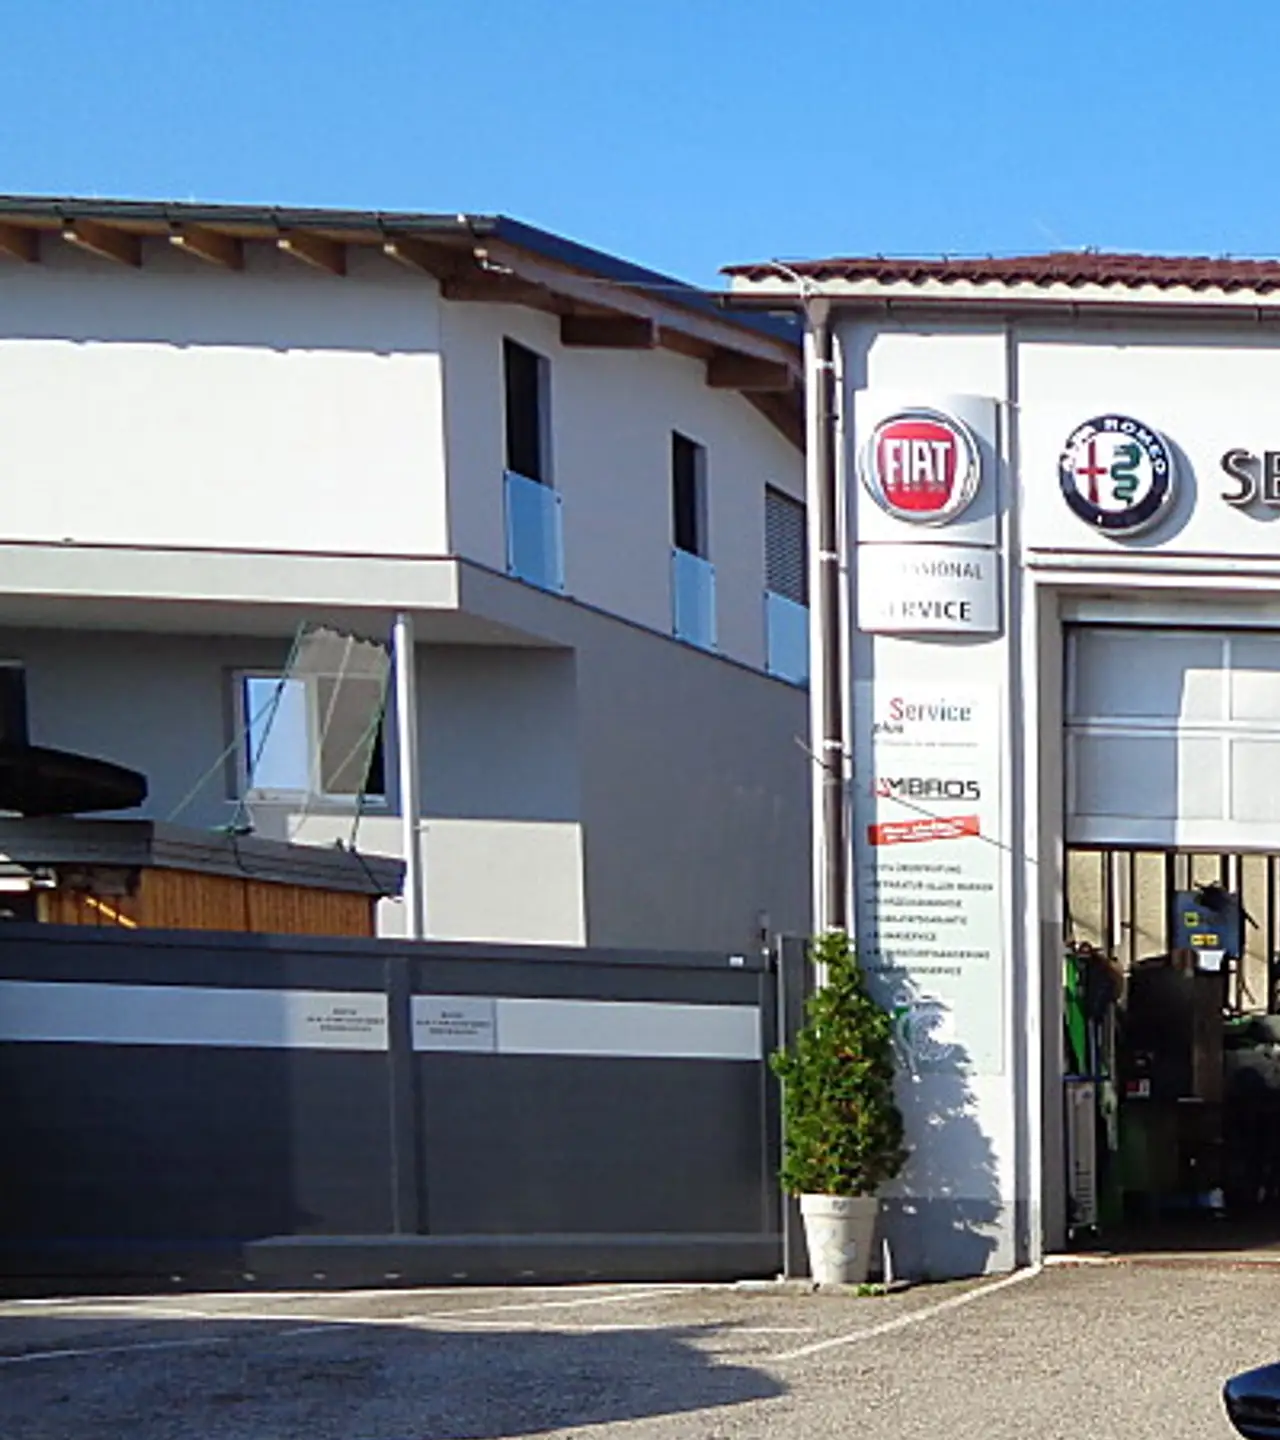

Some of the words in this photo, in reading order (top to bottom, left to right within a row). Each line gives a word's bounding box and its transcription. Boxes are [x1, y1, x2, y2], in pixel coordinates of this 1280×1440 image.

[883, 438, 952, 485] FIAT
[1103, 418, 1167, 475] ROMEO
[890, 697, 971, 722] Service
